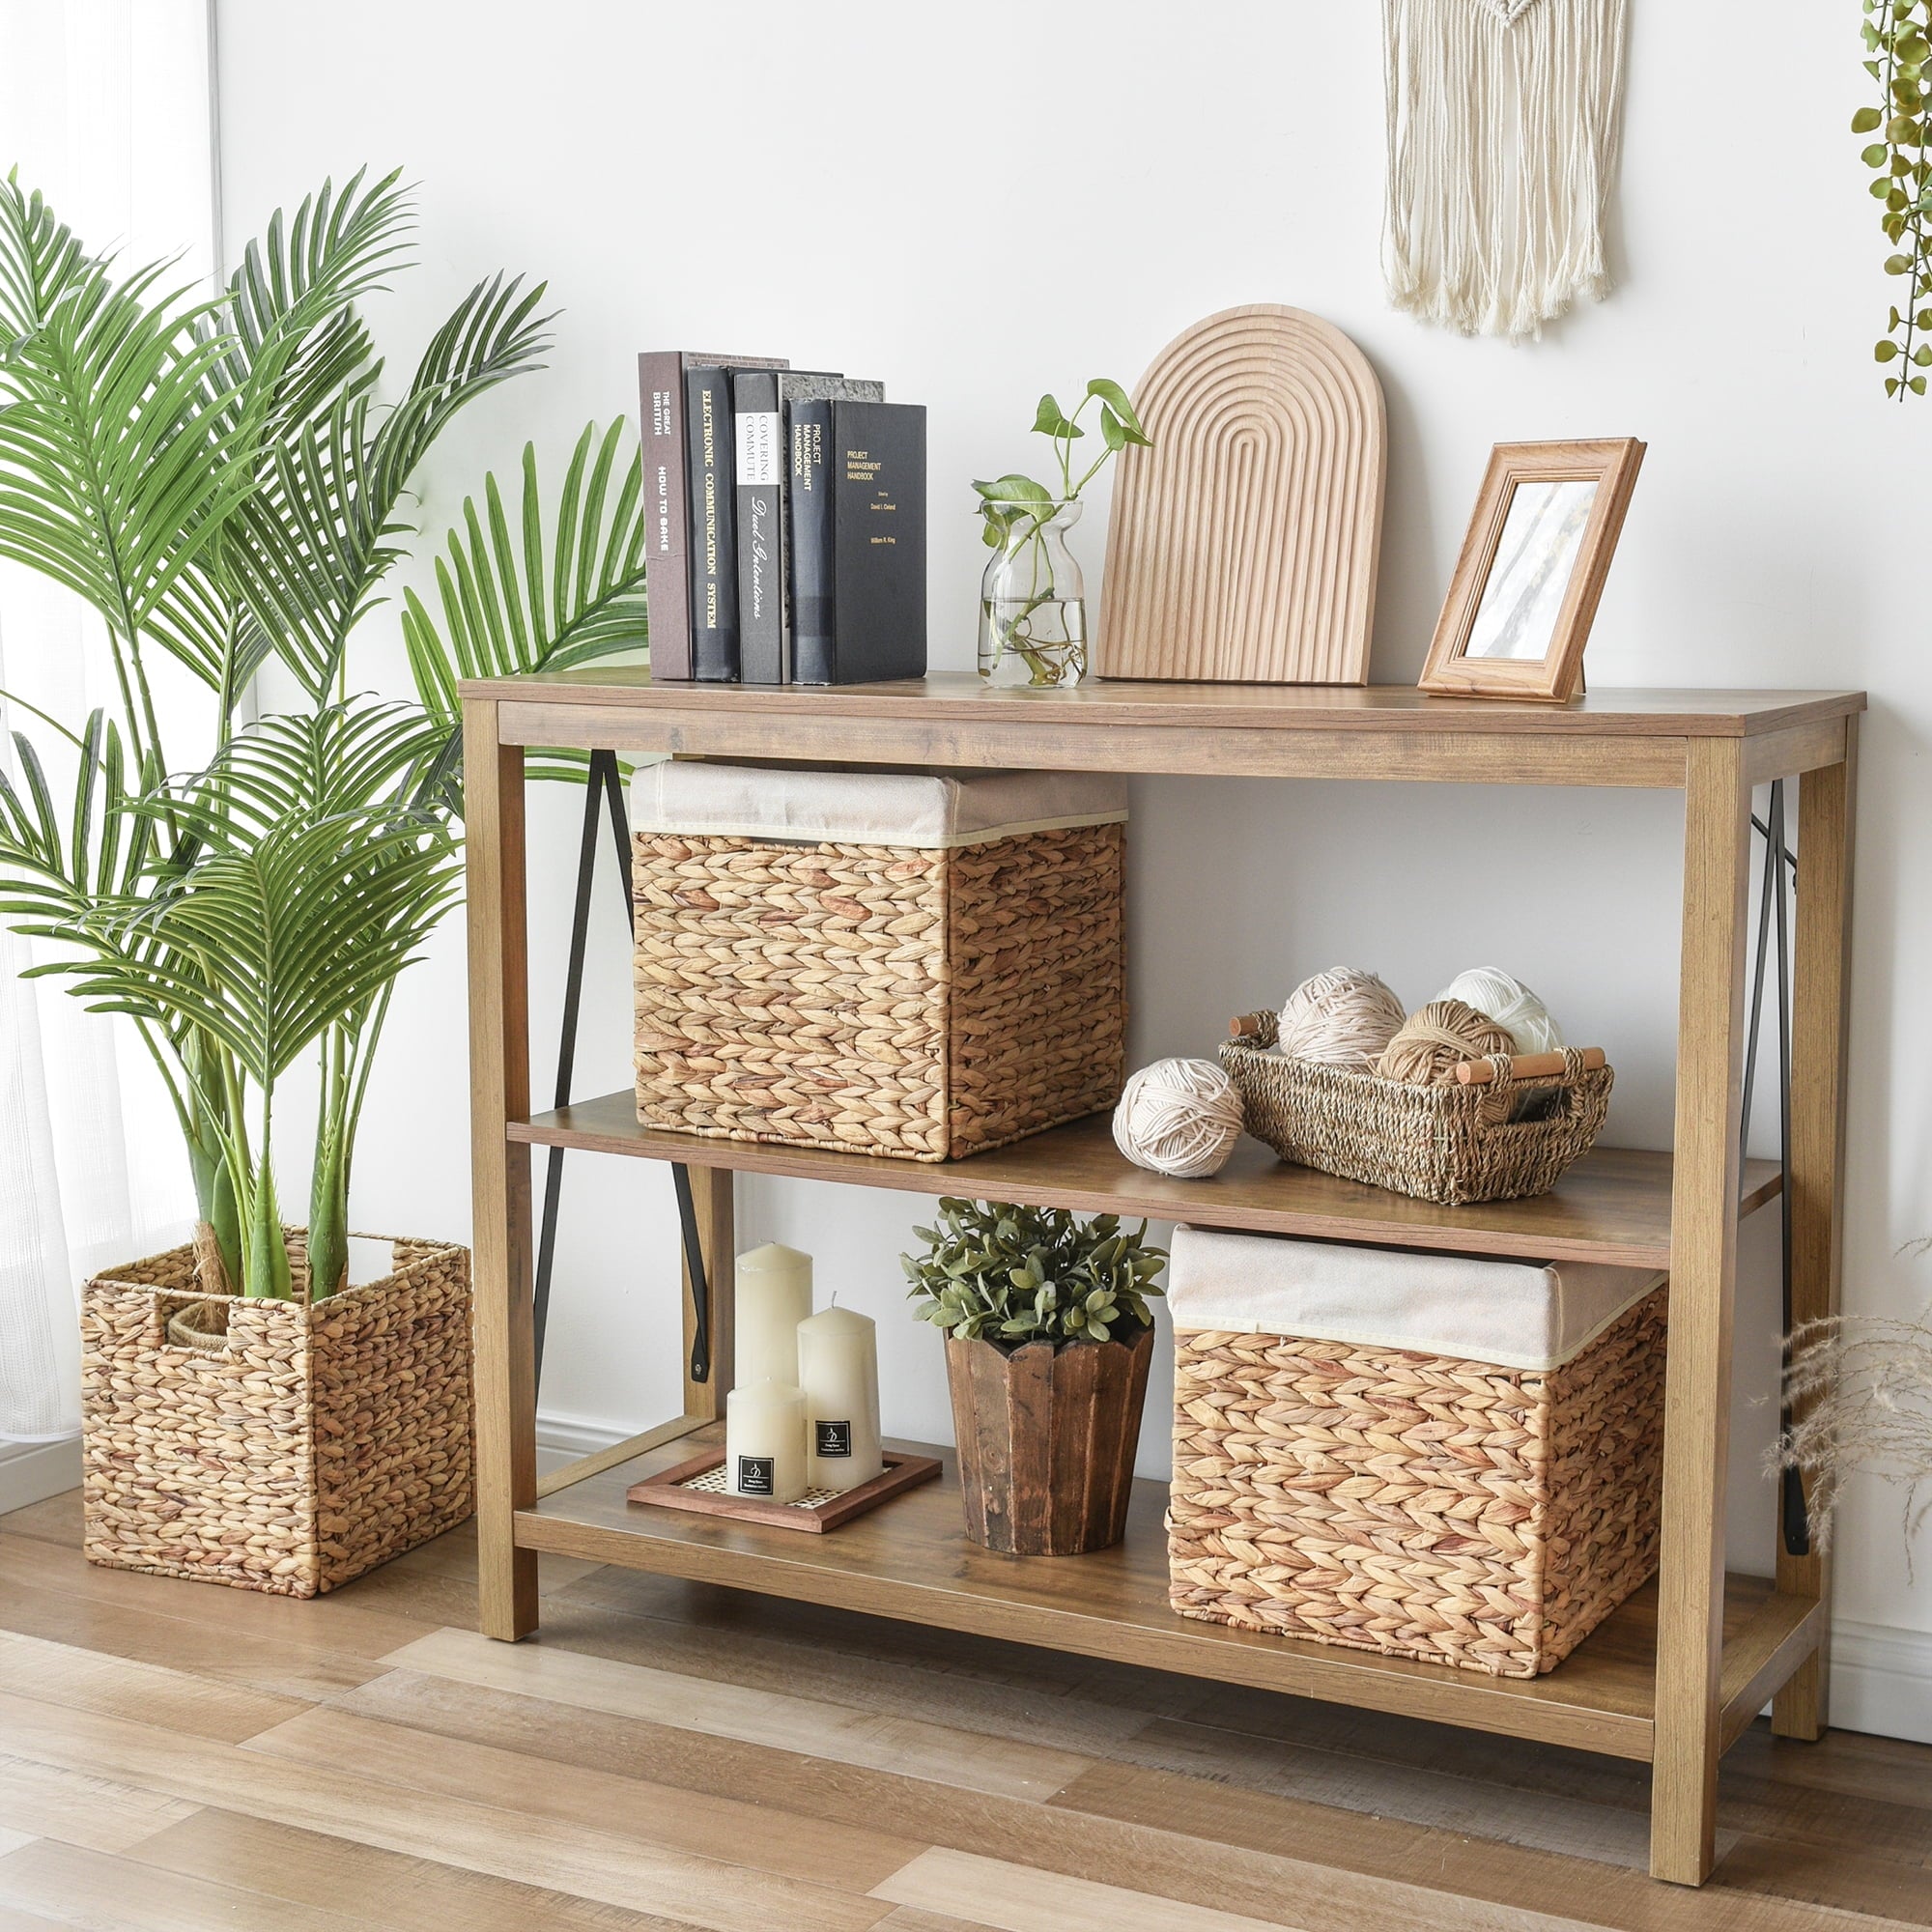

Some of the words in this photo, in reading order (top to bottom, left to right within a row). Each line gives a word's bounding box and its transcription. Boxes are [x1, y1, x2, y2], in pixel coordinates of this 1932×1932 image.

[702, 389, 714, 468] ELECTRONIC
[746, 415, 755, 481] COMMUTE
[759, 415, 769, 481] COVERING
[794, 424, 803, 476] HANDBOOK
[812, 424, 821, 465] PROJECT
[803, 424, 811, 492] MANAGEMENT
[847, 450, 867, 460] PROJECT
[847, 462, 881, 470] MANAGEMENT
[847, 471, 873, 481] HANDBOOK
[659, 466, 668, 496] HOW
[660, 498, 668, 514] TO
[705, 472, 717, 576] COMMUNICATION
[752, 496, 767, 542] Duel
[661, 517, 669, 552] BAKE
[752, 540, 768, 620] Intentions
[707, 582, 717, 629] SYSTEM
